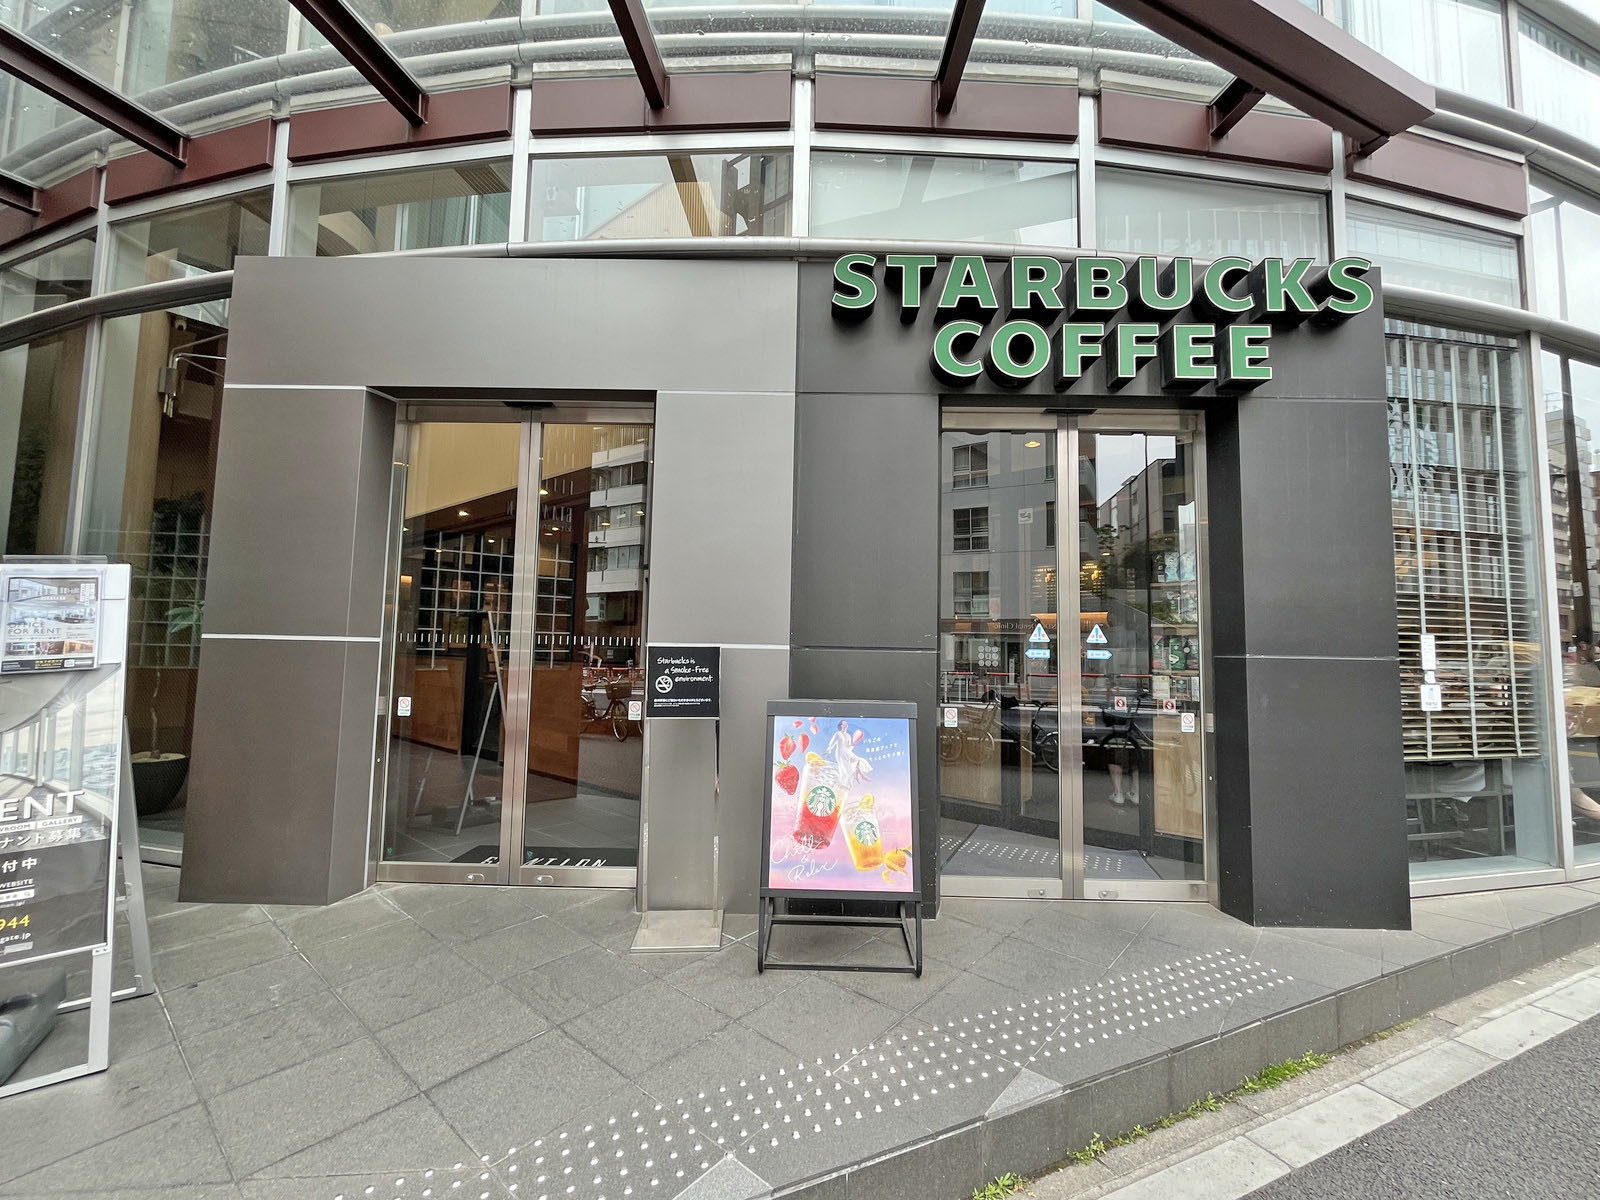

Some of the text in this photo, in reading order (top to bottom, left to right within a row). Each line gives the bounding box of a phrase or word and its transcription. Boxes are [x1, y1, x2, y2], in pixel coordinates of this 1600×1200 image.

[831, 253, 1374, 315] STARBUCKS
[933, 319, 1274, 381] COFFEE
[657, 656, 690, 664] Starbucks
[42, 817, 78, 827] GALLERY
